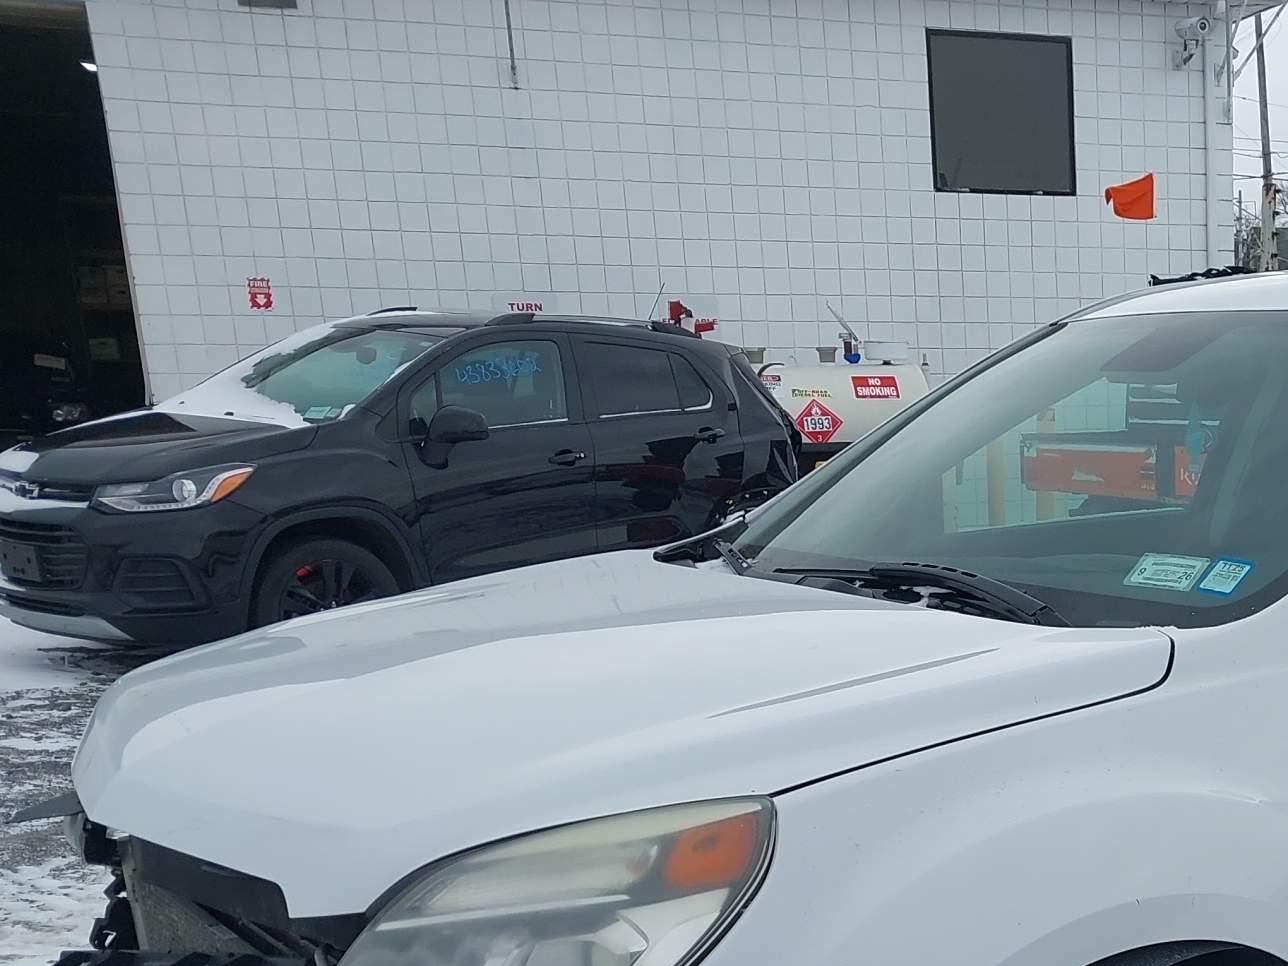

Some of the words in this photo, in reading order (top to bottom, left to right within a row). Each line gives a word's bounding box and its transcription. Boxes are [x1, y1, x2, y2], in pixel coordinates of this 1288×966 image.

[508, 302, 543, 312] TURN
[867, 377, 881, 386] NO
[856, 386, 897, 396] SMOKING
[804, 417, 831, 431] 1993
